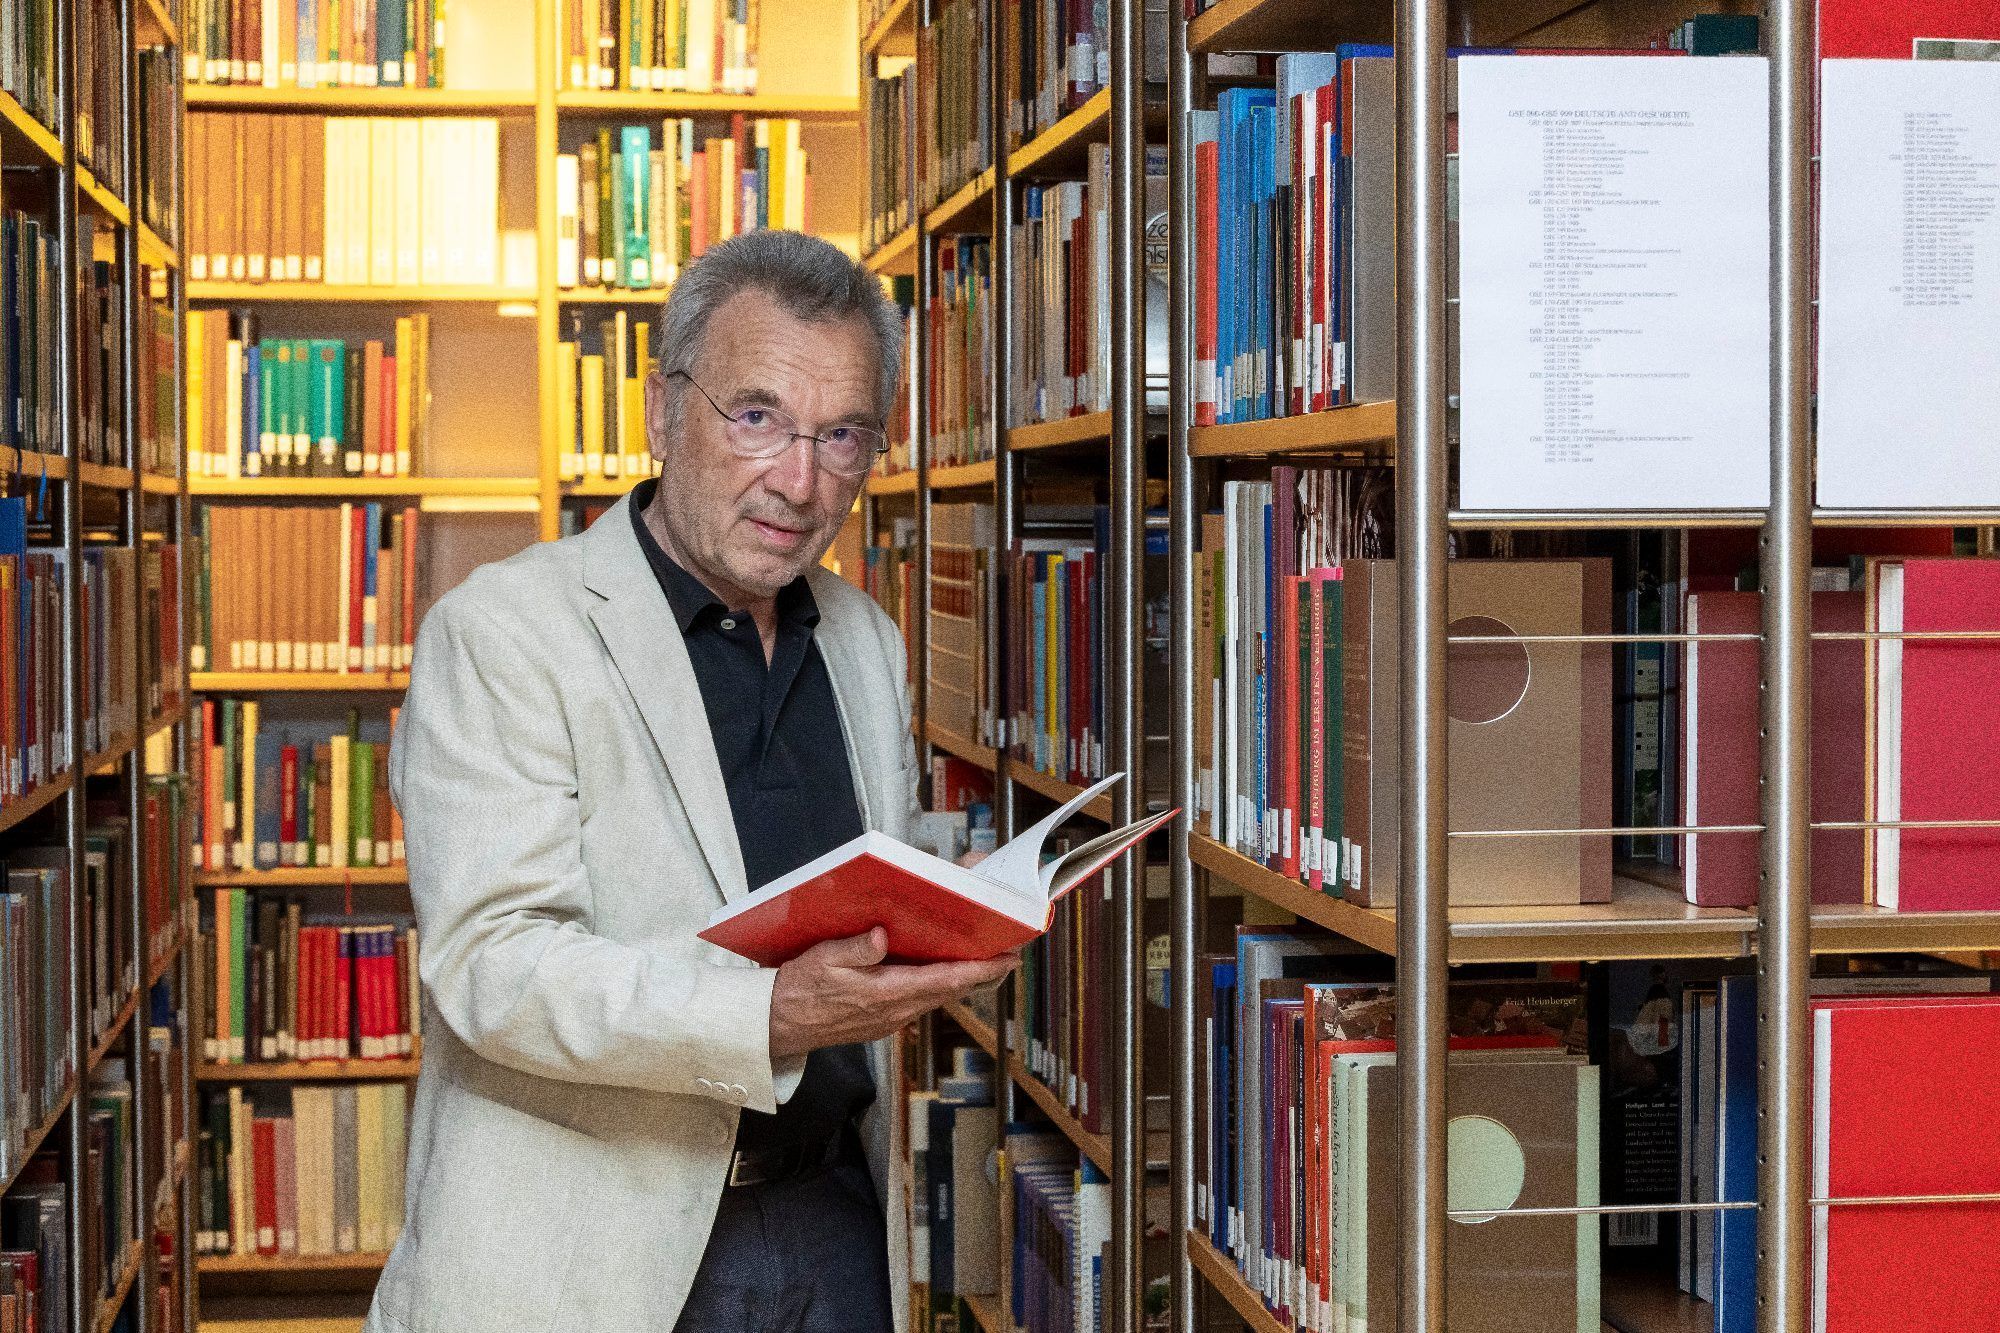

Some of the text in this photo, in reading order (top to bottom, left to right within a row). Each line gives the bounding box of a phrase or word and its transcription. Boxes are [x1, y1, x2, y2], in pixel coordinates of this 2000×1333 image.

[1312, 588, 1321, 818] FREIBURG IM ERSTEN WELTKRIEG
[1527, 996, 1578, 1008] Heimberger
